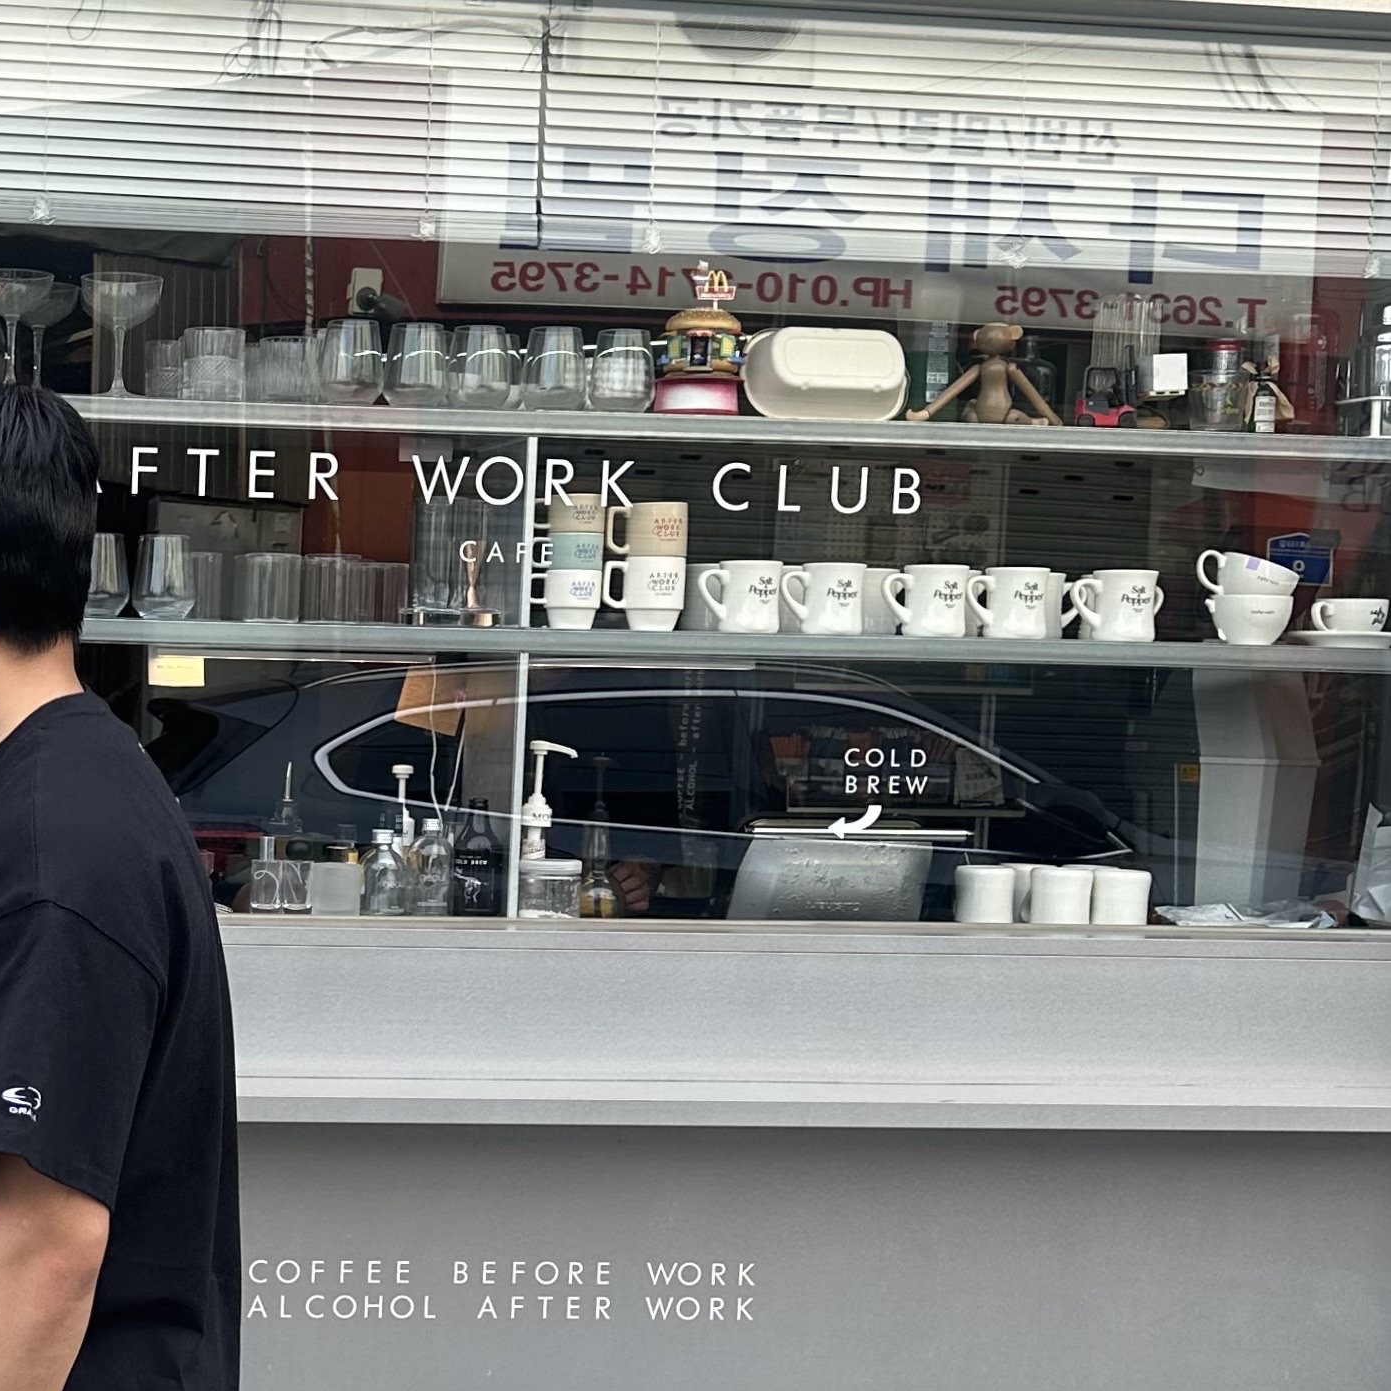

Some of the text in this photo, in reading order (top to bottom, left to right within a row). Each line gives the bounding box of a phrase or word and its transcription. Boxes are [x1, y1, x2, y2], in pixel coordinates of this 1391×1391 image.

[96, 446, 921, 515] FTER WORK CLUB
[459, 540, 554, 565] CAFE
[759, 576, 773, 585] Salt
[837, 579, 852, 588] Salt
[943, 581, 958, 591] Salt
[1023, 582, 1039, 591] Salt
[749, 585, 777, 598] Pepper
[827, 588, 858, 600] Pepper
[933, 590, 963, 602] Pepper
[1132, 585, 1146, 594] Salt
[1014, 591, 1044, 604] Pepper
[1120, 593, 1151, 606] Pepper
[844, 747, 927, 768] COLD
[845, 775, 928, 795] BREW
[248, 1259, 755, 1287] COFFEE BEFORE WORK
[246, 1294, 754, 1321] ALCOHOL AFTER WORK
